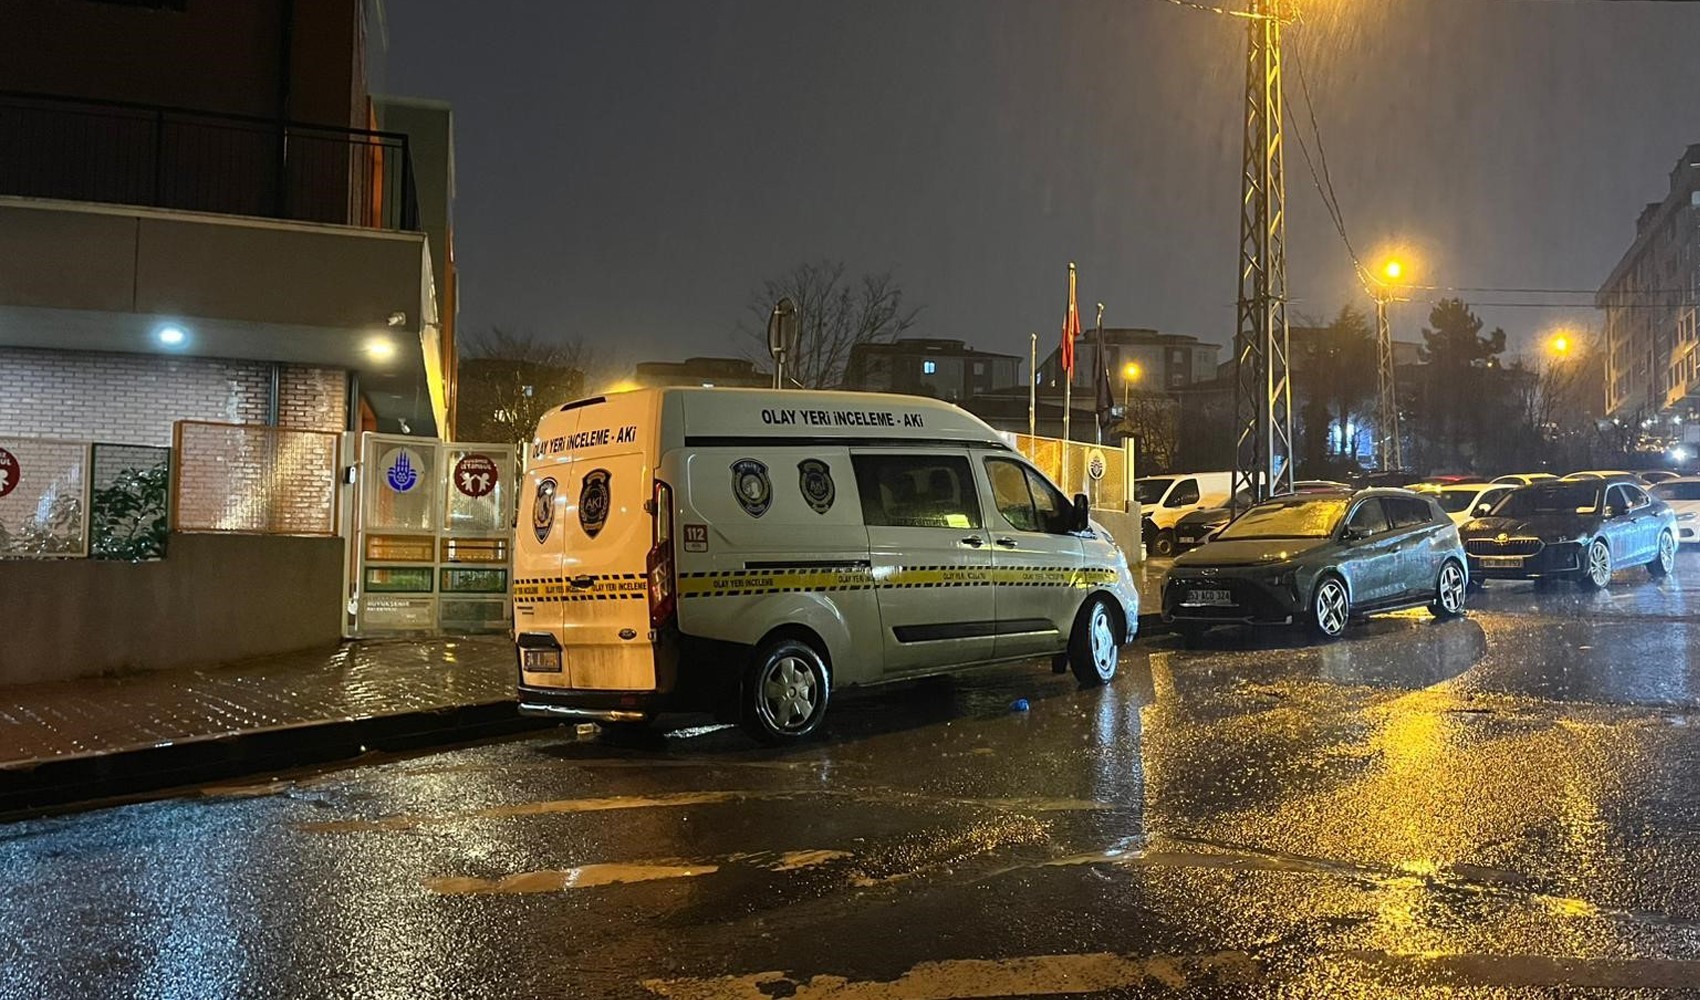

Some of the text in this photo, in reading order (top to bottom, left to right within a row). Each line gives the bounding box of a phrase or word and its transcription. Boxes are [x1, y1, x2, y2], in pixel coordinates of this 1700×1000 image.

[761, 409, 796, 425] OLAY
[687, 527, 705, 541] 112
[713, 580, 729, 588] OLAY
